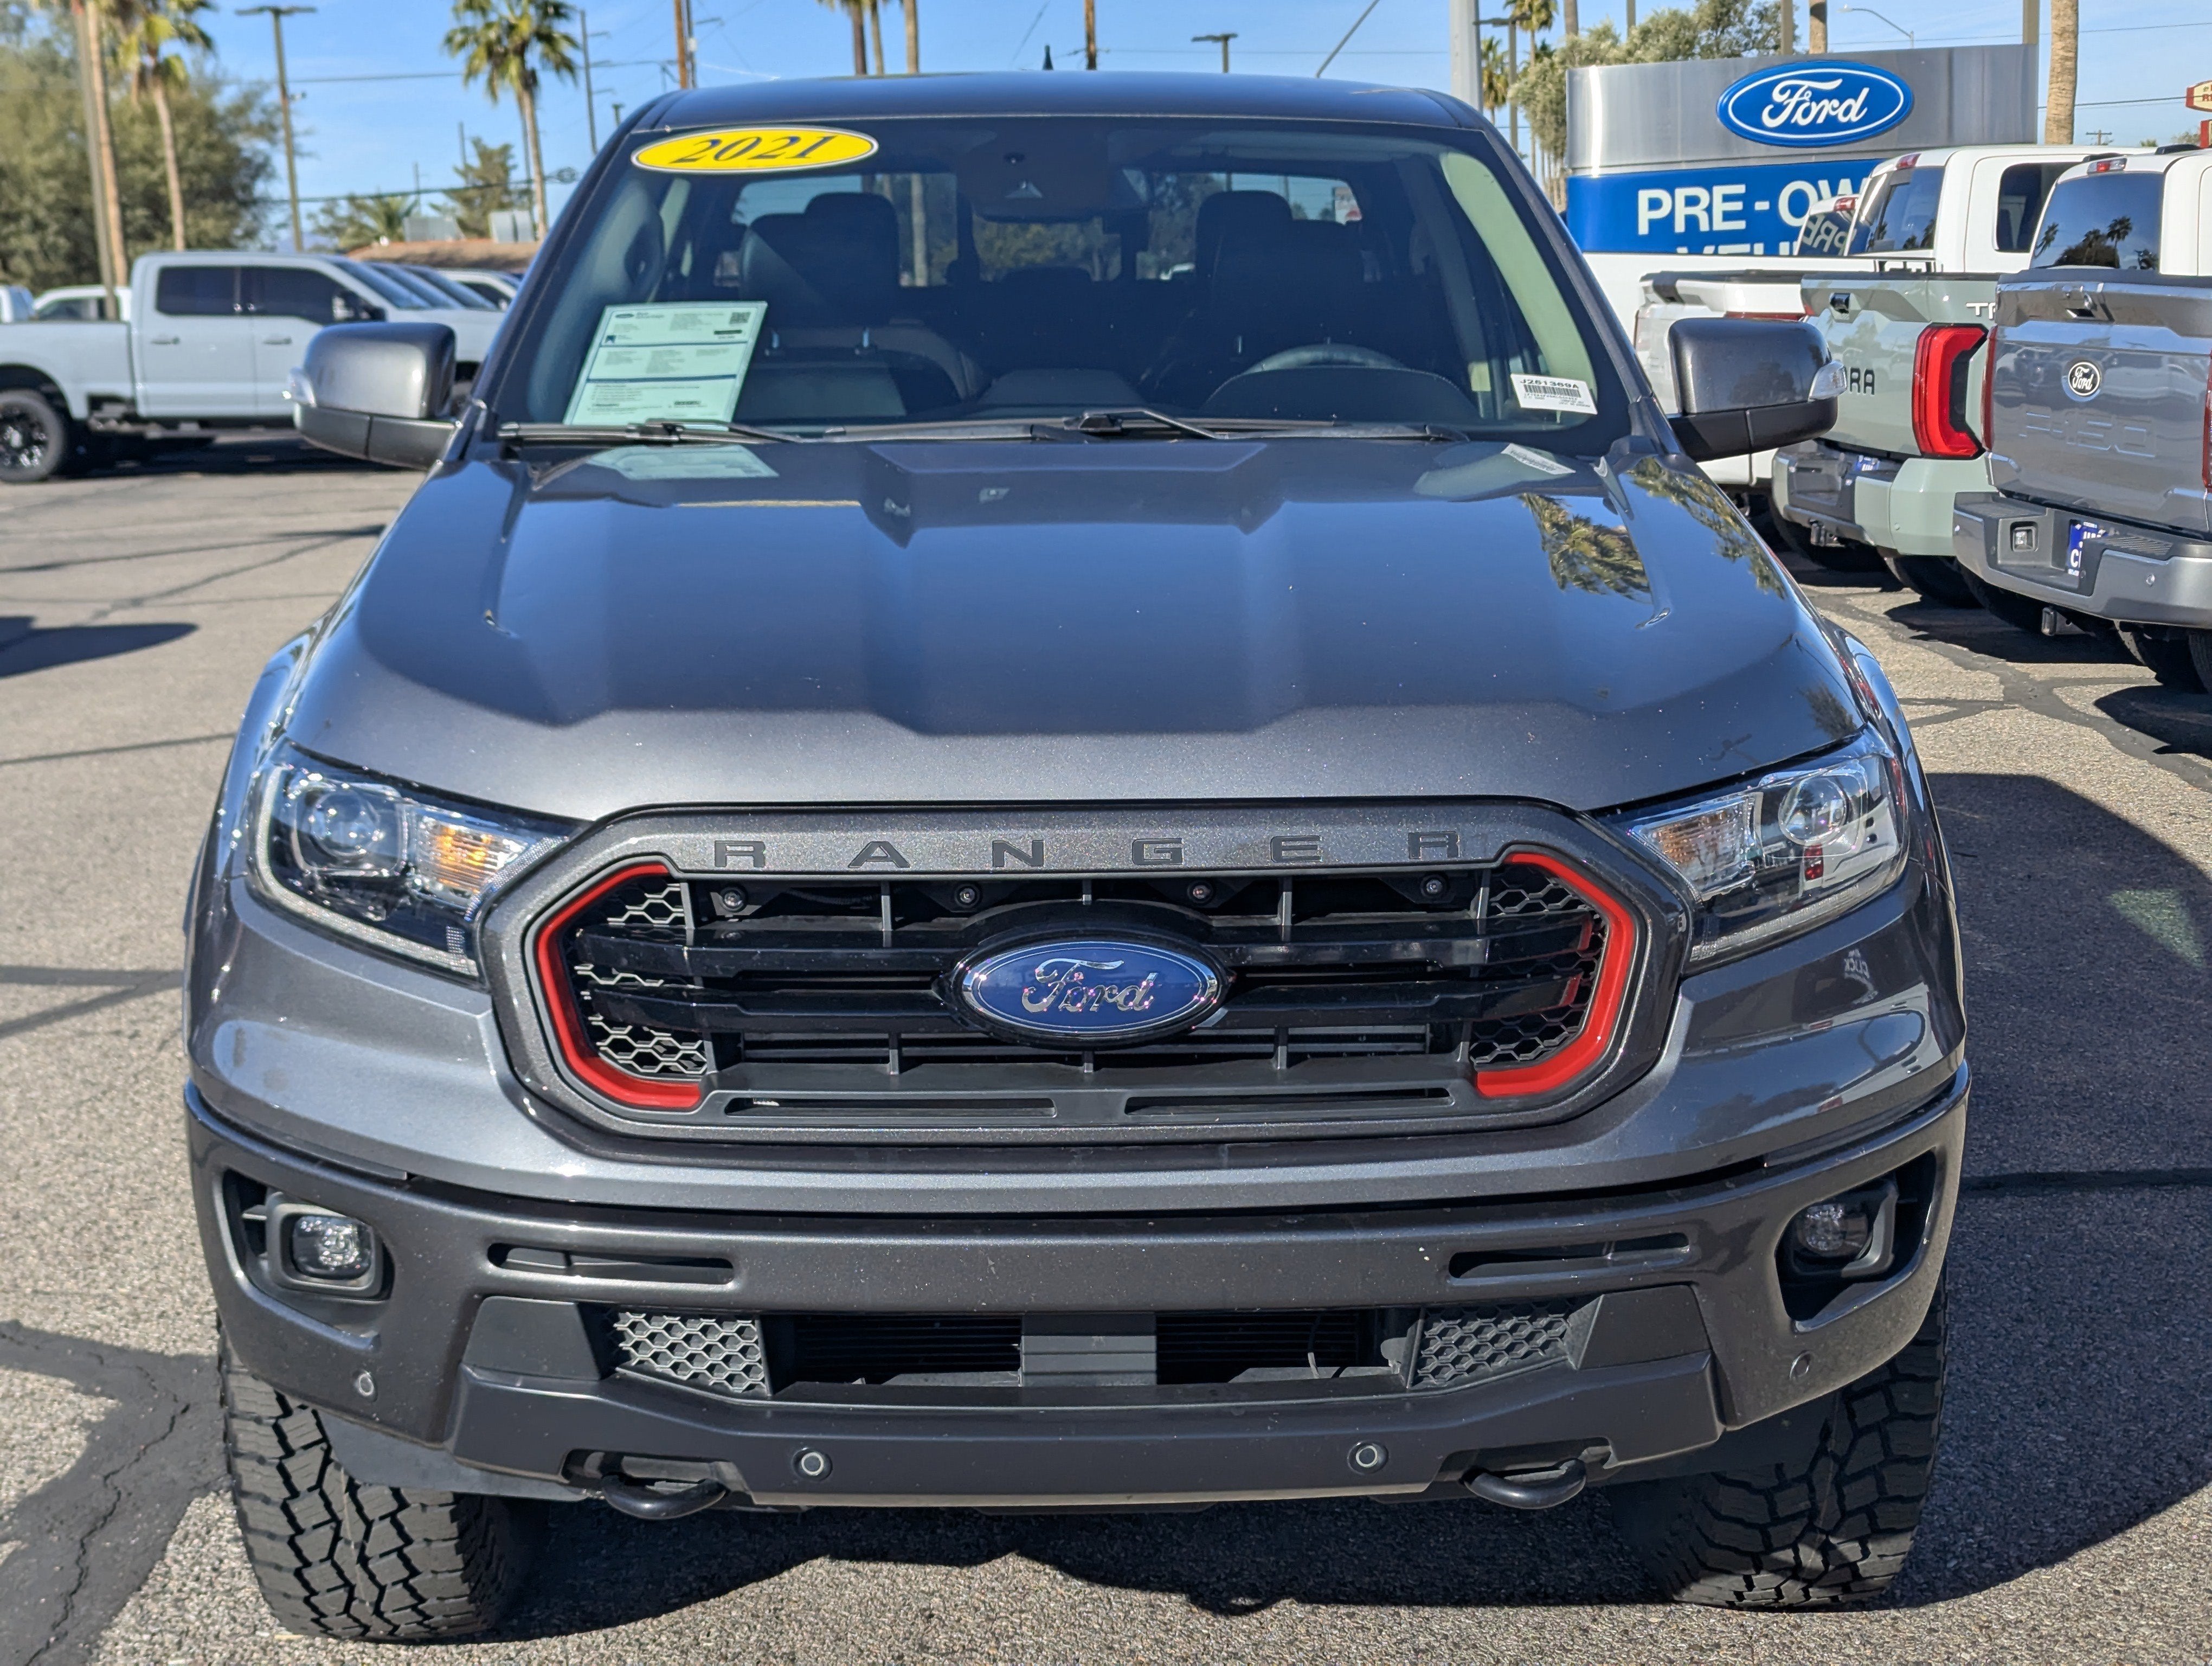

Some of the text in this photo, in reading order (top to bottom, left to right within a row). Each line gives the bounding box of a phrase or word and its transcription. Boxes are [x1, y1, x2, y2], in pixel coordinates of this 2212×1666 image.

[1761, 78, 1870, 128] Ford
[669, 134, 838, 164] 2021
[1844, 366, 1875, 395] RA
[2072, 366, 2094, 390] Ford
[713, 831, 1461, 868] RANGER
[1021, 958, 1158, 1013] Ford
